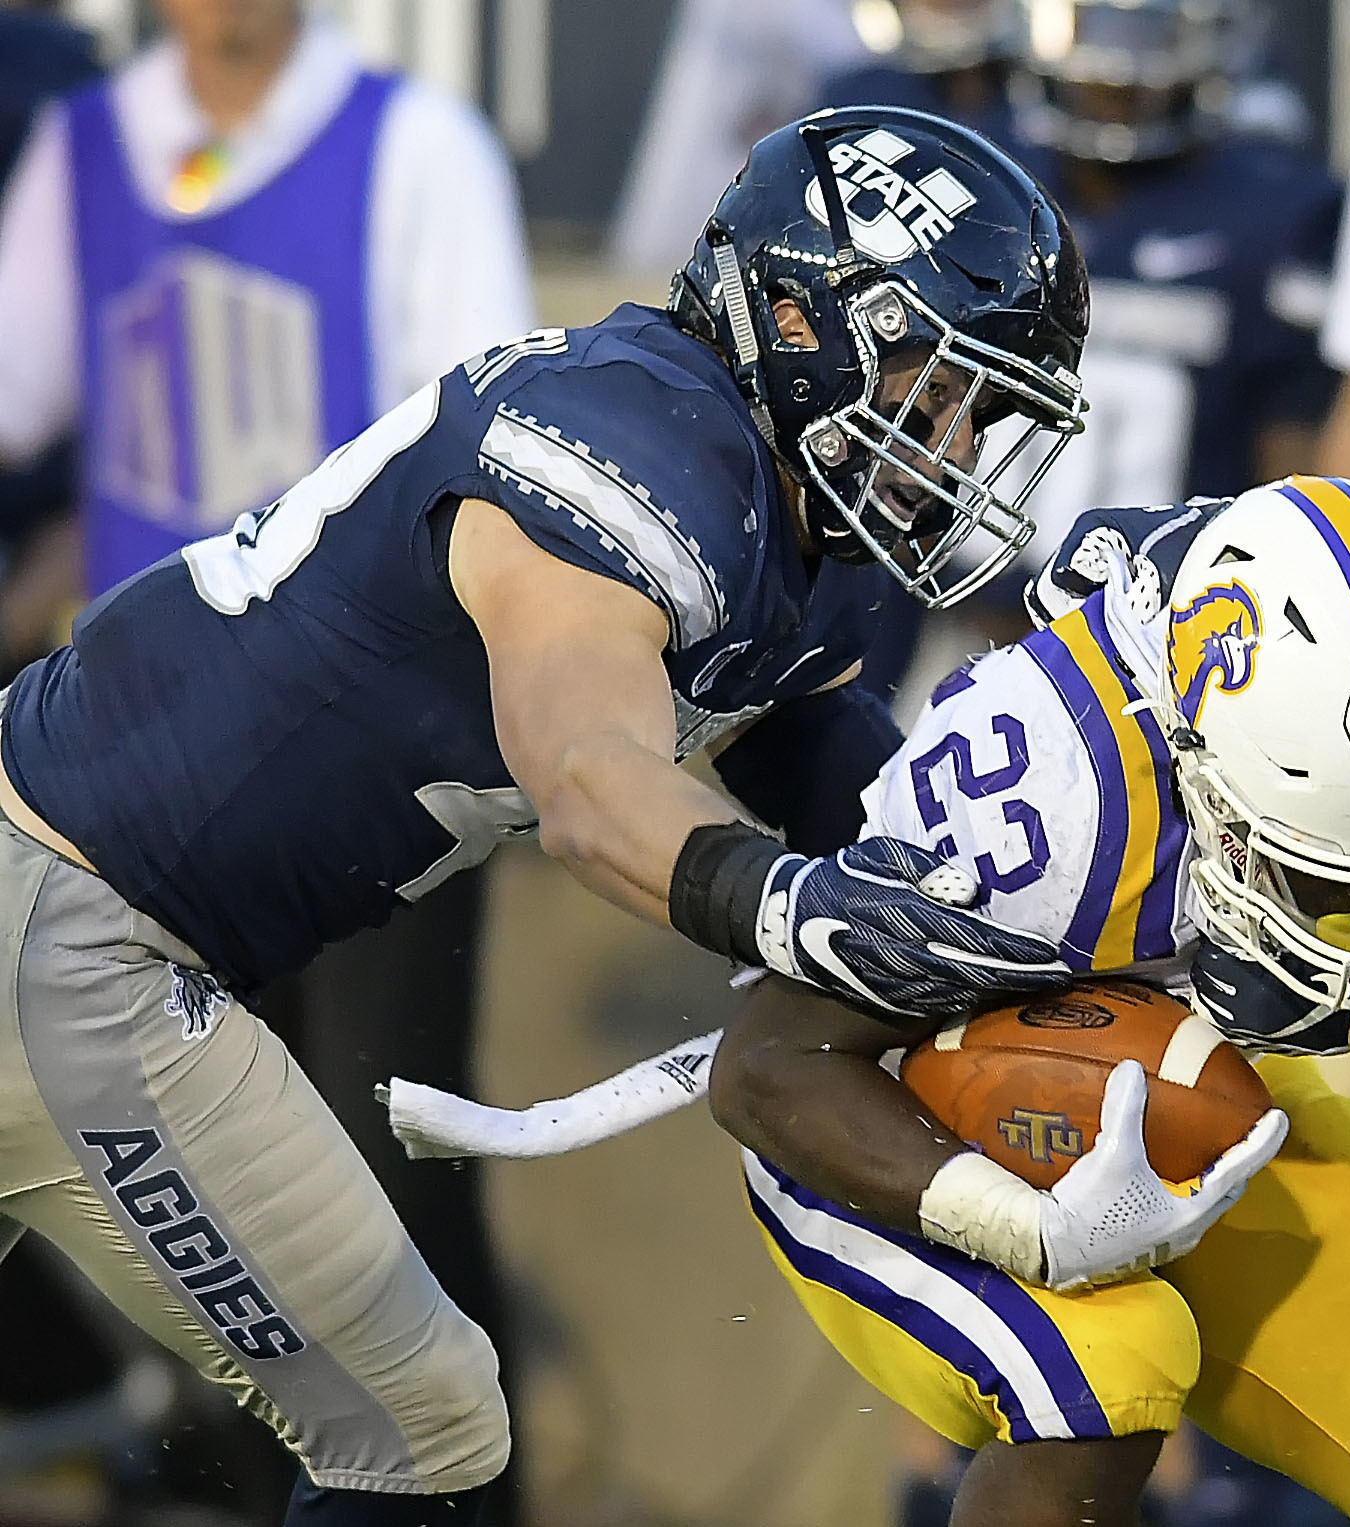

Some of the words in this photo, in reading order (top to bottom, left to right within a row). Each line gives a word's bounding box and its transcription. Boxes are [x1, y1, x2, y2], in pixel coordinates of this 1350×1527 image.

[828, 143, 956, 252] STATE
[910, 712, 1051, 909] 23
[997, 1106, 1083, 1163] TTU
[77, 1127, 307, 1361] AGGIES
